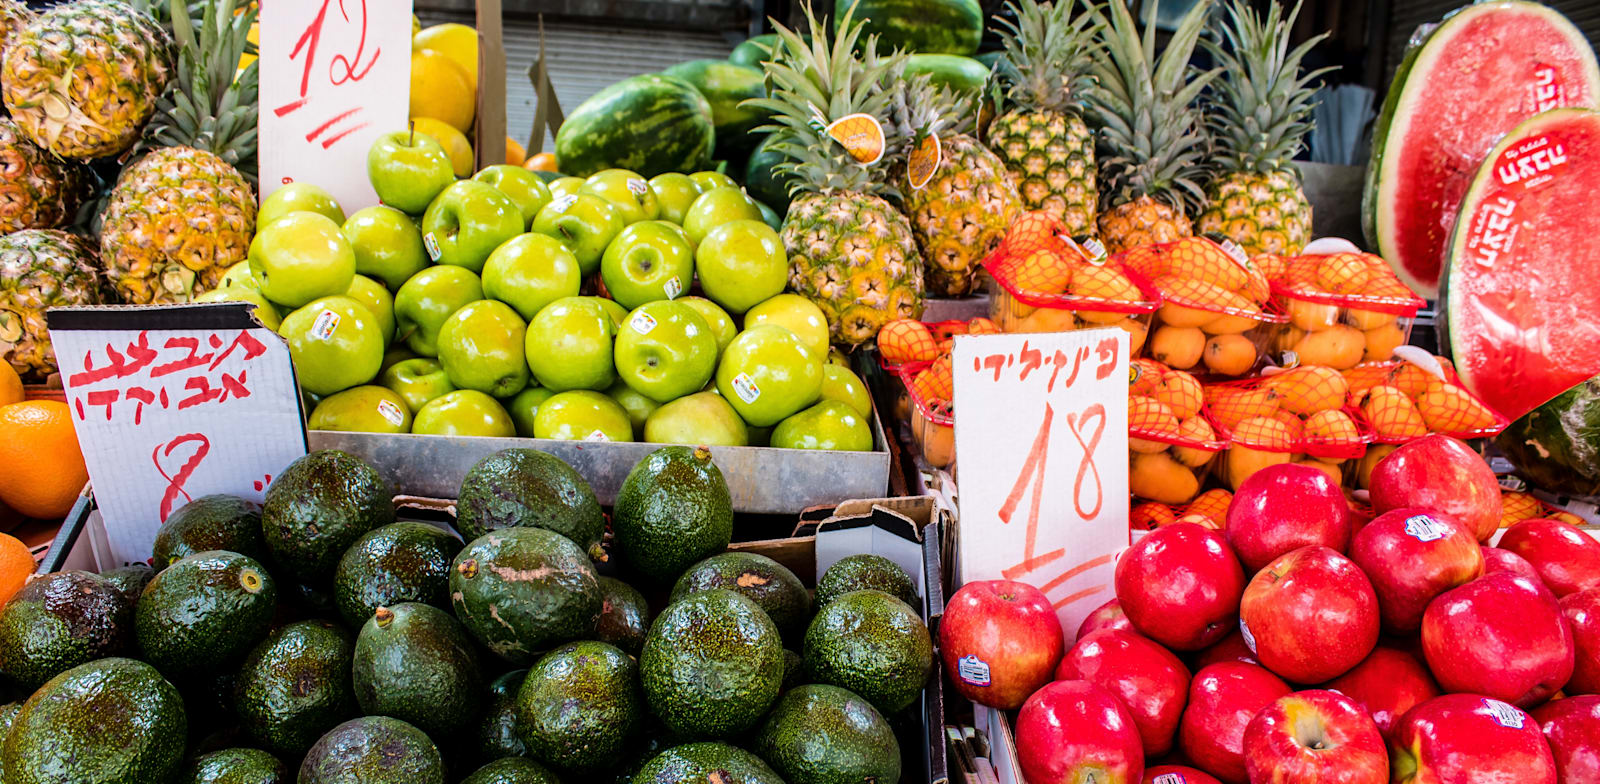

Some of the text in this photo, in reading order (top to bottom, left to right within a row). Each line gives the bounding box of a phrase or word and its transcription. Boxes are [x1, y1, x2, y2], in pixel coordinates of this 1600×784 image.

[273, 0, 381, 117] 12
[1535, 68, 1557, 113] צבה
[1499, 144, 1567, 185] חצבה
[1476, 196, 1516, 268] חצבה
[75, 369, 251, 426] אבוקדו
[152, 432, 210, 523] 8
[999, 401, 1106, 580] 18
